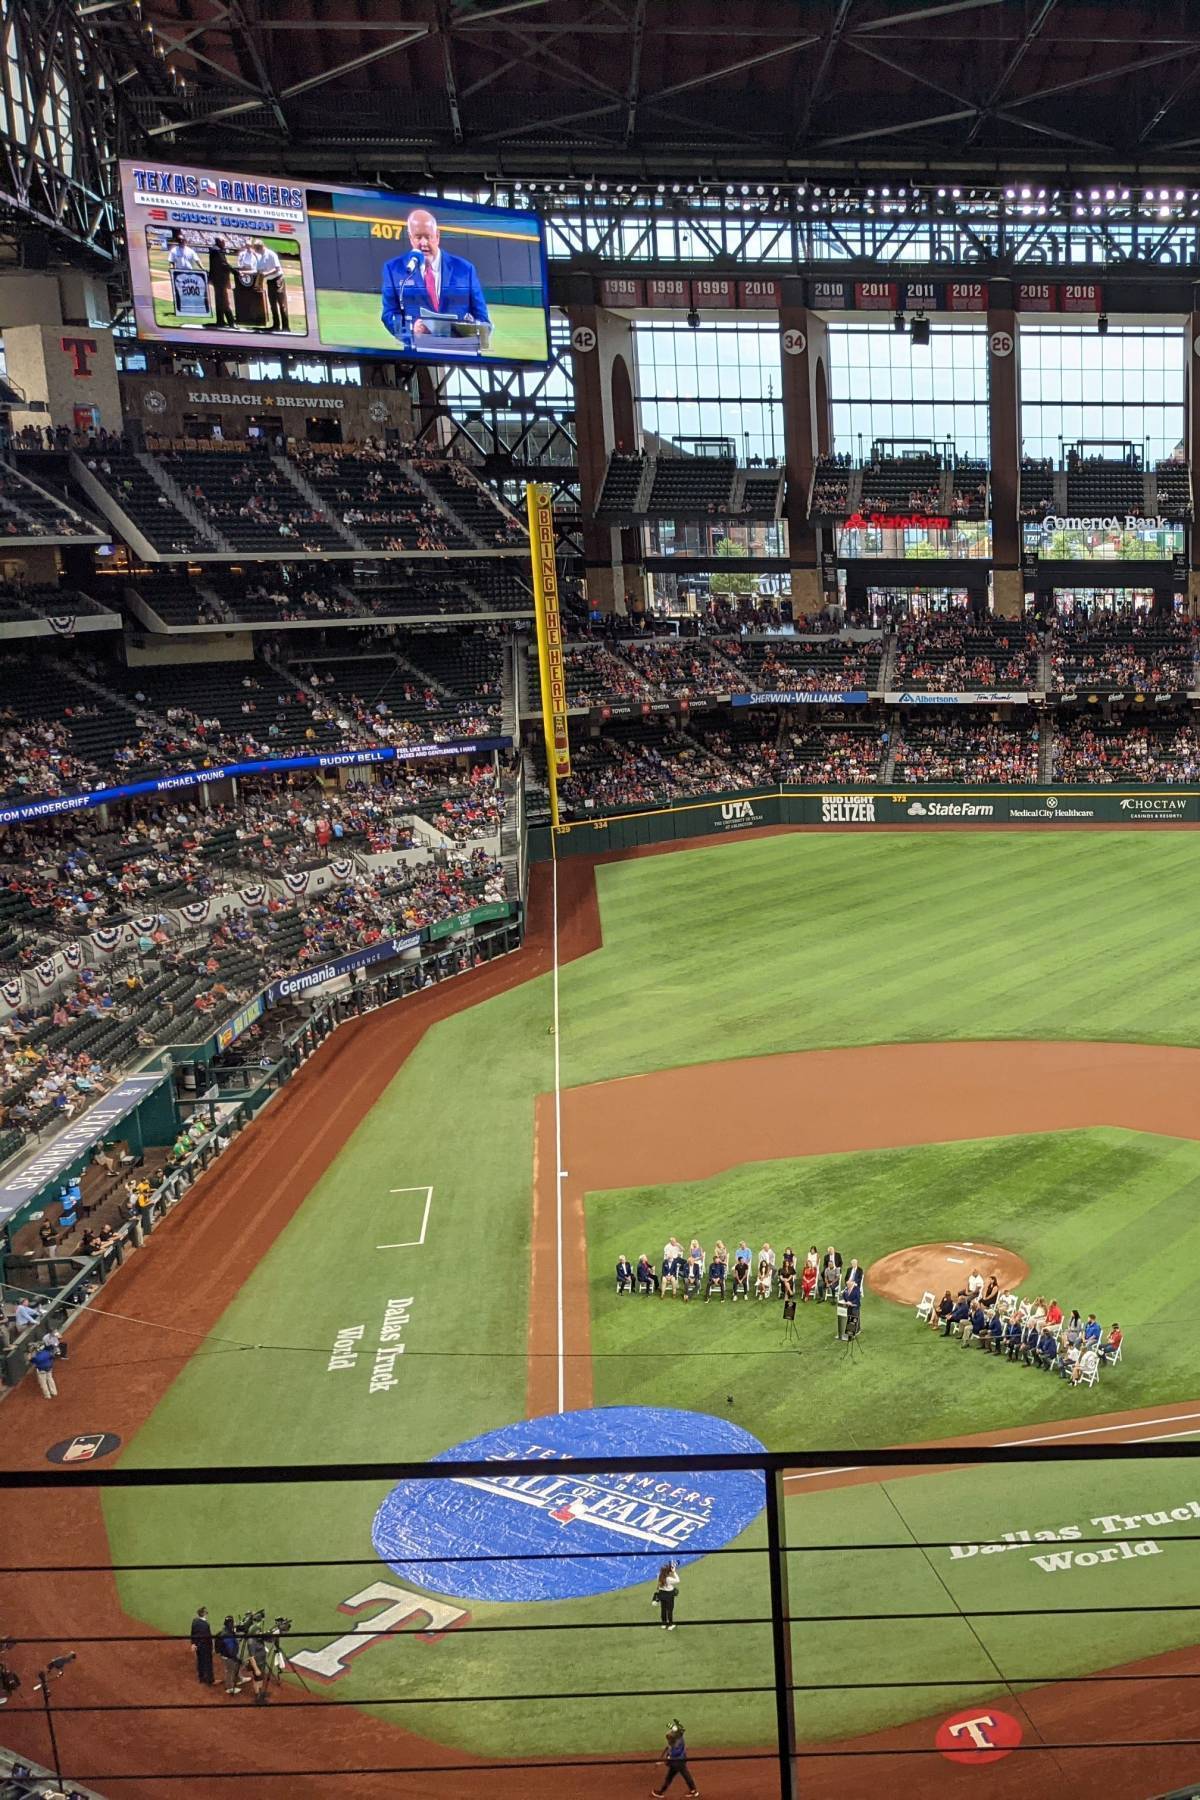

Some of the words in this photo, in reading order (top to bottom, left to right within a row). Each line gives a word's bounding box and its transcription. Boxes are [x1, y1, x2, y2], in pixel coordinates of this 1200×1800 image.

[133, 168, 198, 196] TEXAS
[218, 179, 303, 208] RANGERS
[141, 196, 179, 206] BASEBALL
[181, 200, 200, 208] HALL
[171, 212, 216, 225] CHUCK
[221, 217, 275, 231] MORGAN
[371, 222, 402, 241] 407
[605, 280, 636, 293] 1996
[652, 280, 684, 293] 1998
[698, 281, 729, 294] 1999
[745, 282, 775, 294] 2010
[815, 283, 843, 296] 2010
[862, 284, 889, 296] 2011
[907, 284, 934, 297] 2011
[952, 284, 982, 297] 2012
[1020, 285, 1049, 298] 2015
[1065, 285, 1095, 298] 2016
[574, 332, 593, 346] 42
[785, 335, 803, 349] 34
[992, 337, 1010, 350] 26
[60, 338, 97, 377] T
[188, 392, 262, 405] KARBACH
[276, 397, 344, 409] BREWING
[1124, 515, 1167, 531] Bank
[539, 509, 553, 592] BRING
[546, 595, 560, 644] THE
[550, 650, 564, 713] HEAT
[750, 692, 843, 704] SHERWIN-WILLIAMS
[915, 695, 959, 703] Albertsons
[976, 693, 992, 701] Tom
[993, 692, 1013, 701] Thumb
[320, 754, 355, 766] BUDDY
[357, 751, 384, 762] BELL
[157, 776, 196, 791] MICHAEL
[197, 770, 225, 783] YOUNG
[822, 796, 845, 804] BUD
[846, 796, 875, 804] LIGHT
[892, 795, 907, 803] 372
[1127, 799, 1187, 809] CHOCTAW
[0, 811, 20, 821] TOM
[21, 796, 90, 817] VANDERGRIFF
[721, 801, 754, 820] UTA
[822, 804, 876, 822] SELTZER
[1010, 809, 1038, 817] Medical
[1038, 809, 1053, 819] City
[1054, 809, 1094, 817] Healthcare
[557, 826, 571, 834] 329
[594, 821, 608, 830] 334
[280, 965, 336, 995] Germania
[337, 953, 381, 975] INSURANCE
[380, 1296, 414, 1342] Dallas
[327, 1324, 365, 1371] World
[369, 1343, 405, 1394] Truck
[572, 1486, 600, 1499] OF
[589, 1494, 706, 1541] FAME
[949, 1524, 1083, 1560] Dallas
[1030, 1539, 1163, 1572] World
[949, 1714, 996, 1749] T
